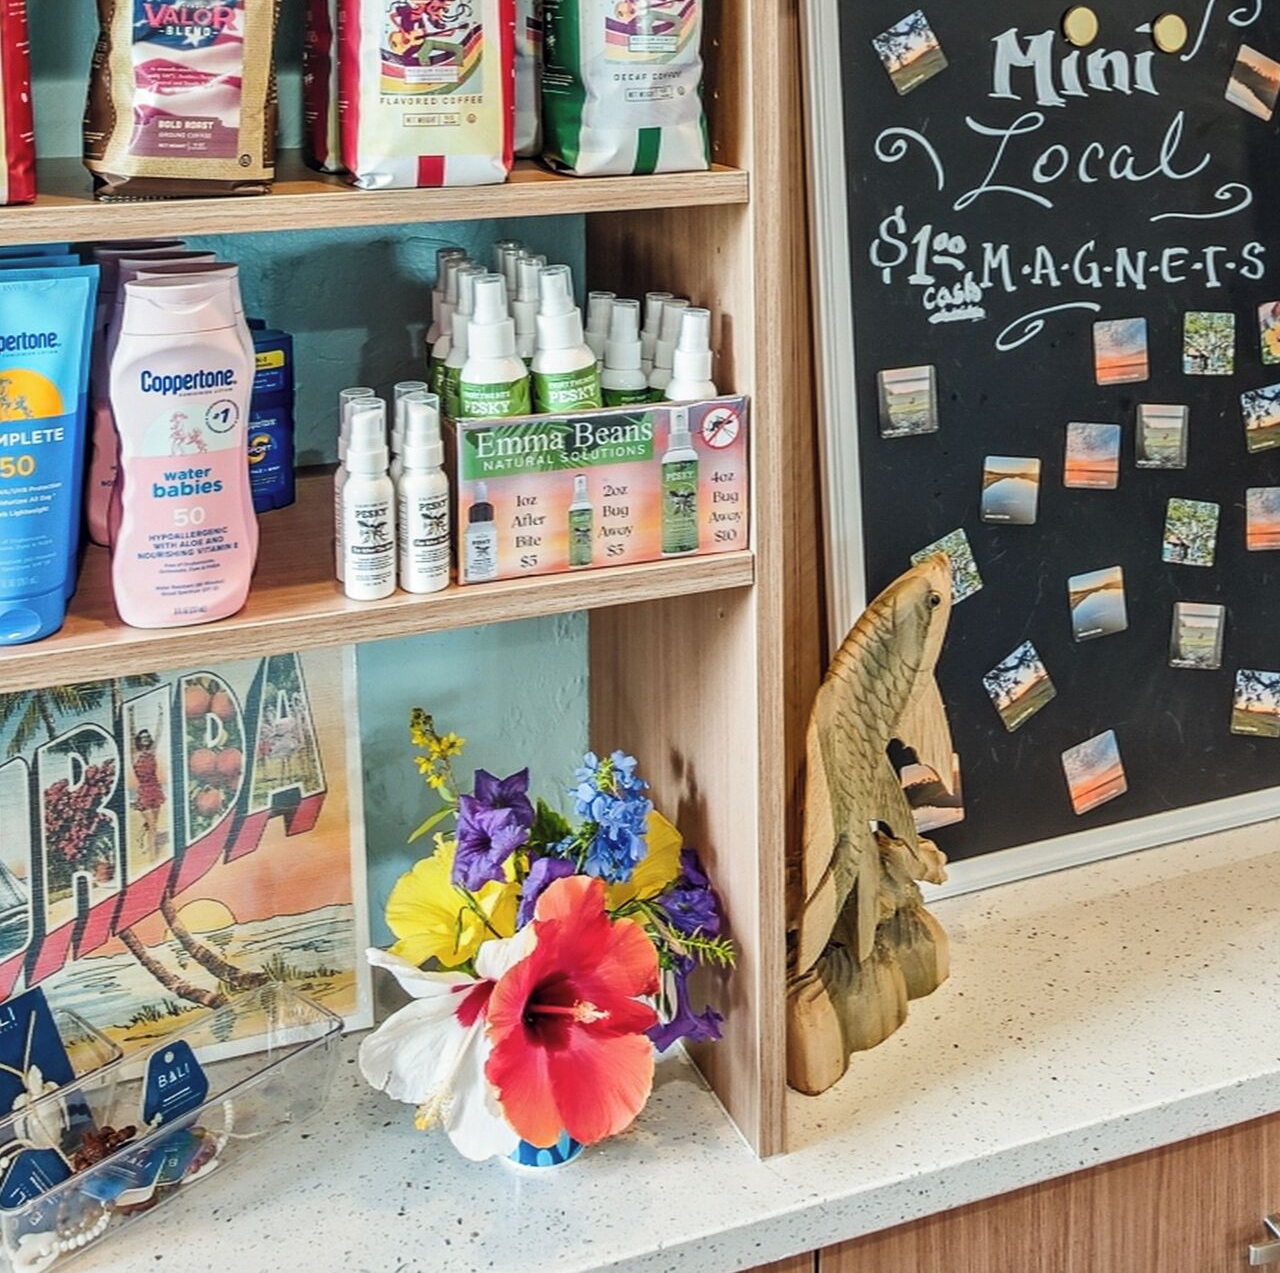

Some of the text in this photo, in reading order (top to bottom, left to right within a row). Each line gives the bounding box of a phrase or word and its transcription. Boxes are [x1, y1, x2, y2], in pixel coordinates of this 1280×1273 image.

[143, 2, 239, 32] VALOR
[164, 25, 214, 38] BLEND
[988, 27, 1160, 108] Mini
[379, 95, 484, 106] FLAVORED COFFEE
[953, 110, 1212, 211] Local
[140, 368, 234, 397] Coppertone
[549, 384, 597, 404] PESKY
[476, 422, 653, 459] Emma Beans
[483, 444, 646, 471] NATURAL SOLUTIONS
[163, 467, 212, 482] water
[152, 479, 224, 499] babies
[602, 484, 629, 498] 2oz
[419, 499, 449, 512] PESKY
[712, 491, 740, 506] Bug
[173, 505, 206, 528] 50
[355, 508, 388, 520] PESKY
[511, 513, 547, 528] After
[602, 506, 630, 520] Bug
[707, 511, 744, 525] Away
[597, 525, 634, 539] Away
[152, 535, 225, 550] WITH ALOE AND
[515, 535, 543, 549] Bite
[158, 1062, 191, 1089] BALI
